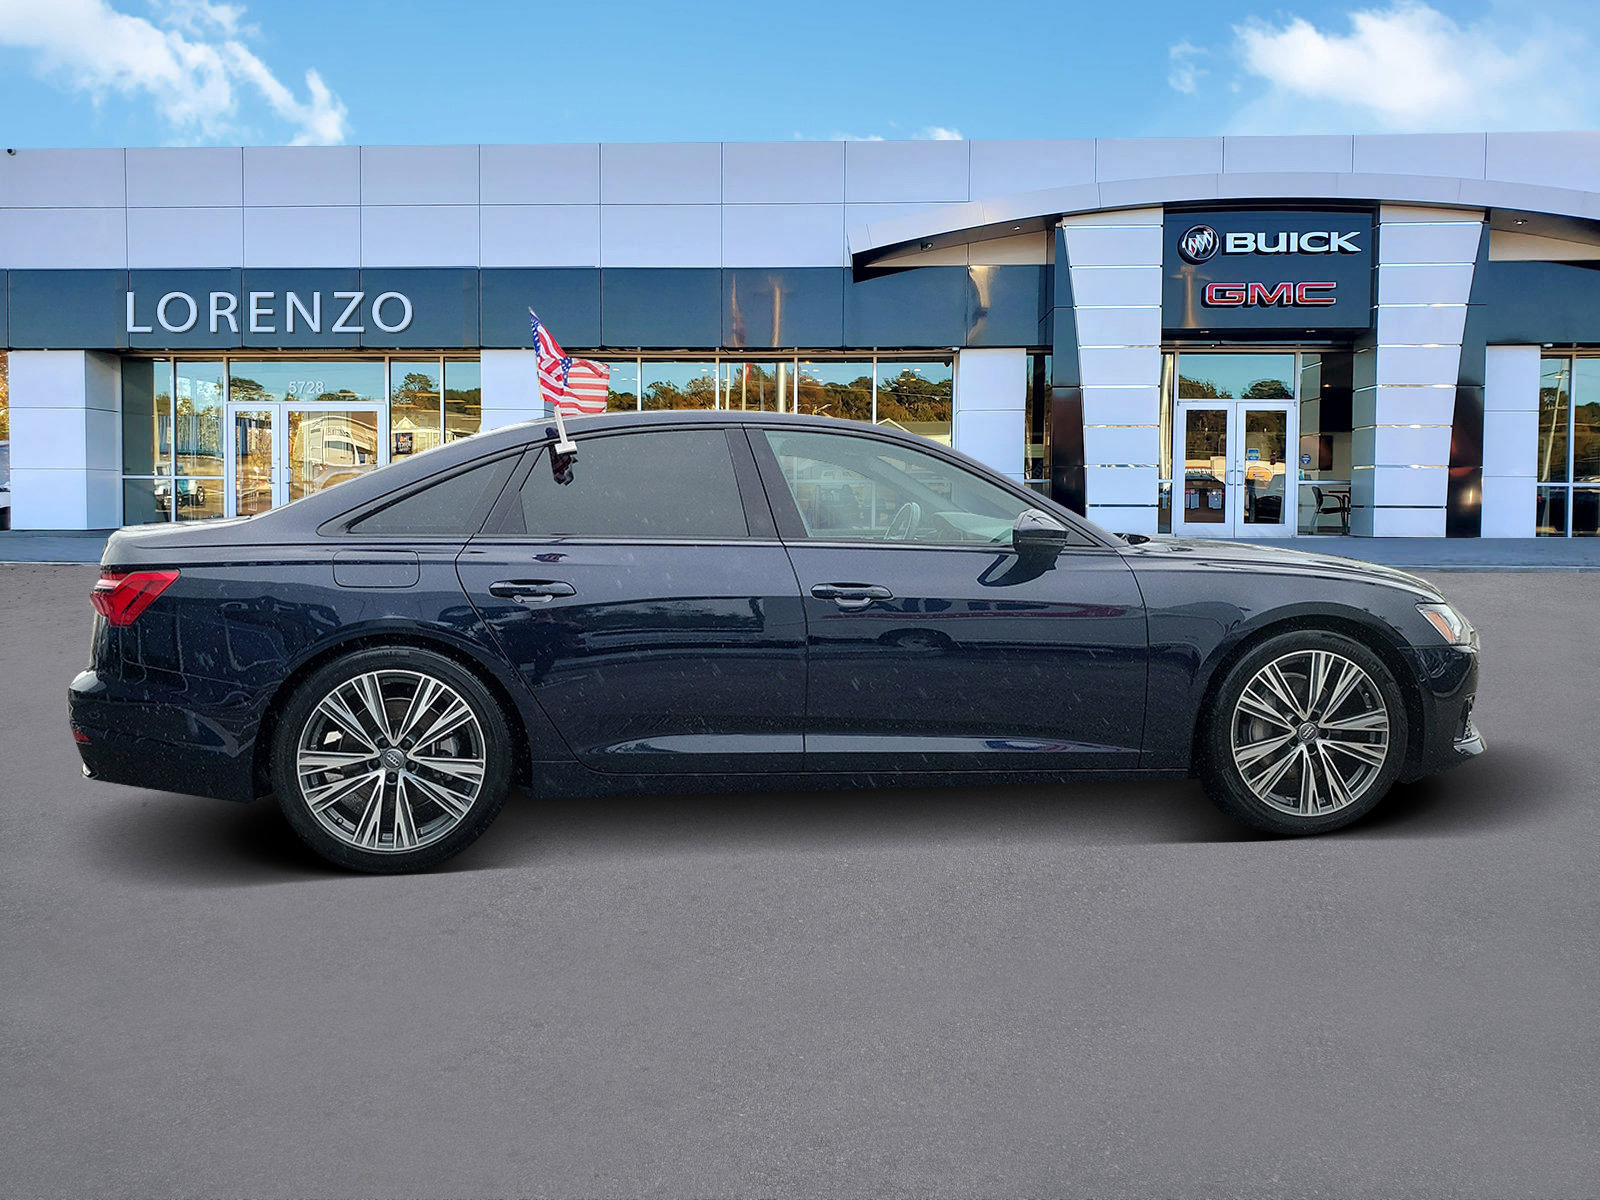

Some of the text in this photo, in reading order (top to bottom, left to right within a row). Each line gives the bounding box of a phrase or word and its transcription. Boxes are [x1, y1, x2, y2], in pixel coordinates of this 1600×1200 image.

[1225, 231, 1362, 254] BUICK
[1205, 281, 1337, 306] GMC
[126, 291, 414, 333] LORENZO
[288, 381, 325, 394] 5728
